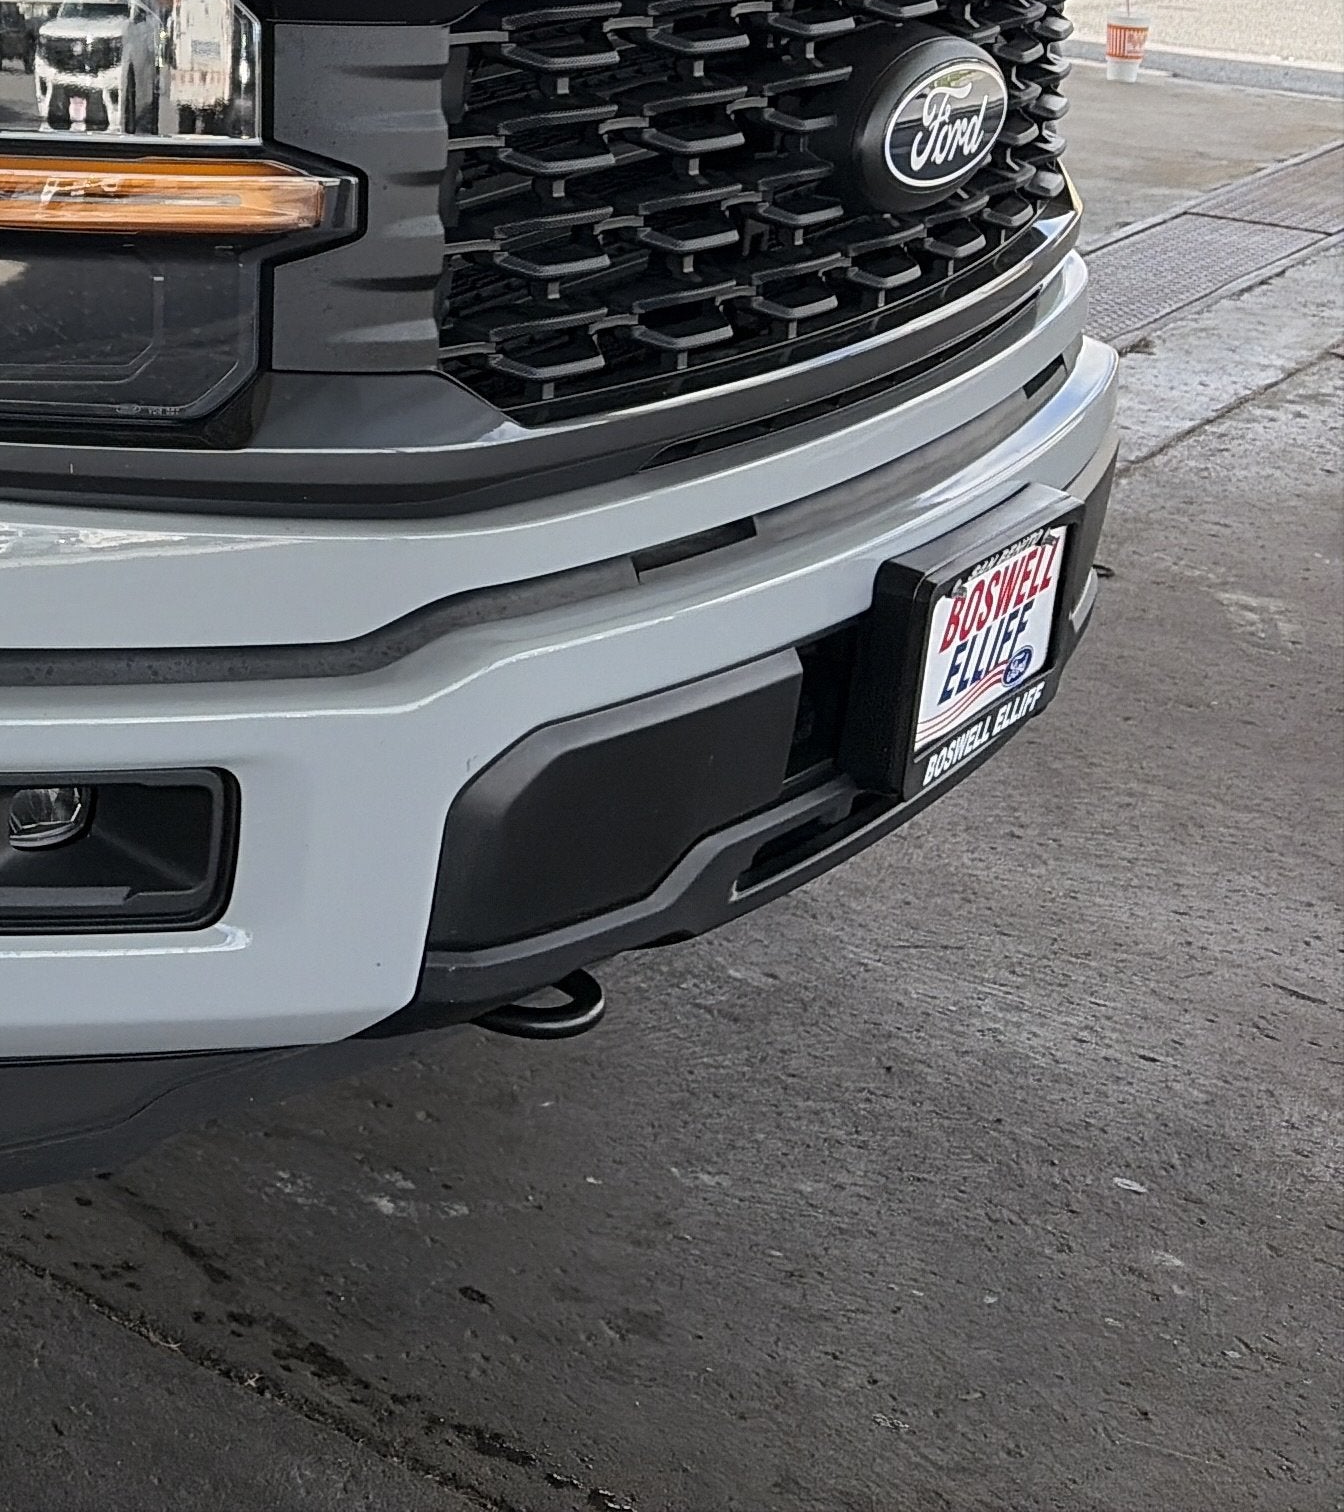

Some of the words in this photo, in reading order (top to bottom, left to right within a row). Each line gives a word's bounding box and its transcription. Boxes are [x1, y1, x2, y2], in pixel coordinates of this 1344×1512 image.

[910, 82, 989, 172] Ford
[938, 535, 1061, 654] BOSWELL
[937, 599, 1035, 707] ELLIFF
[923, 716, 995, 787] BOSWELL
[993, 681, 1046, 736] ELLIFF
